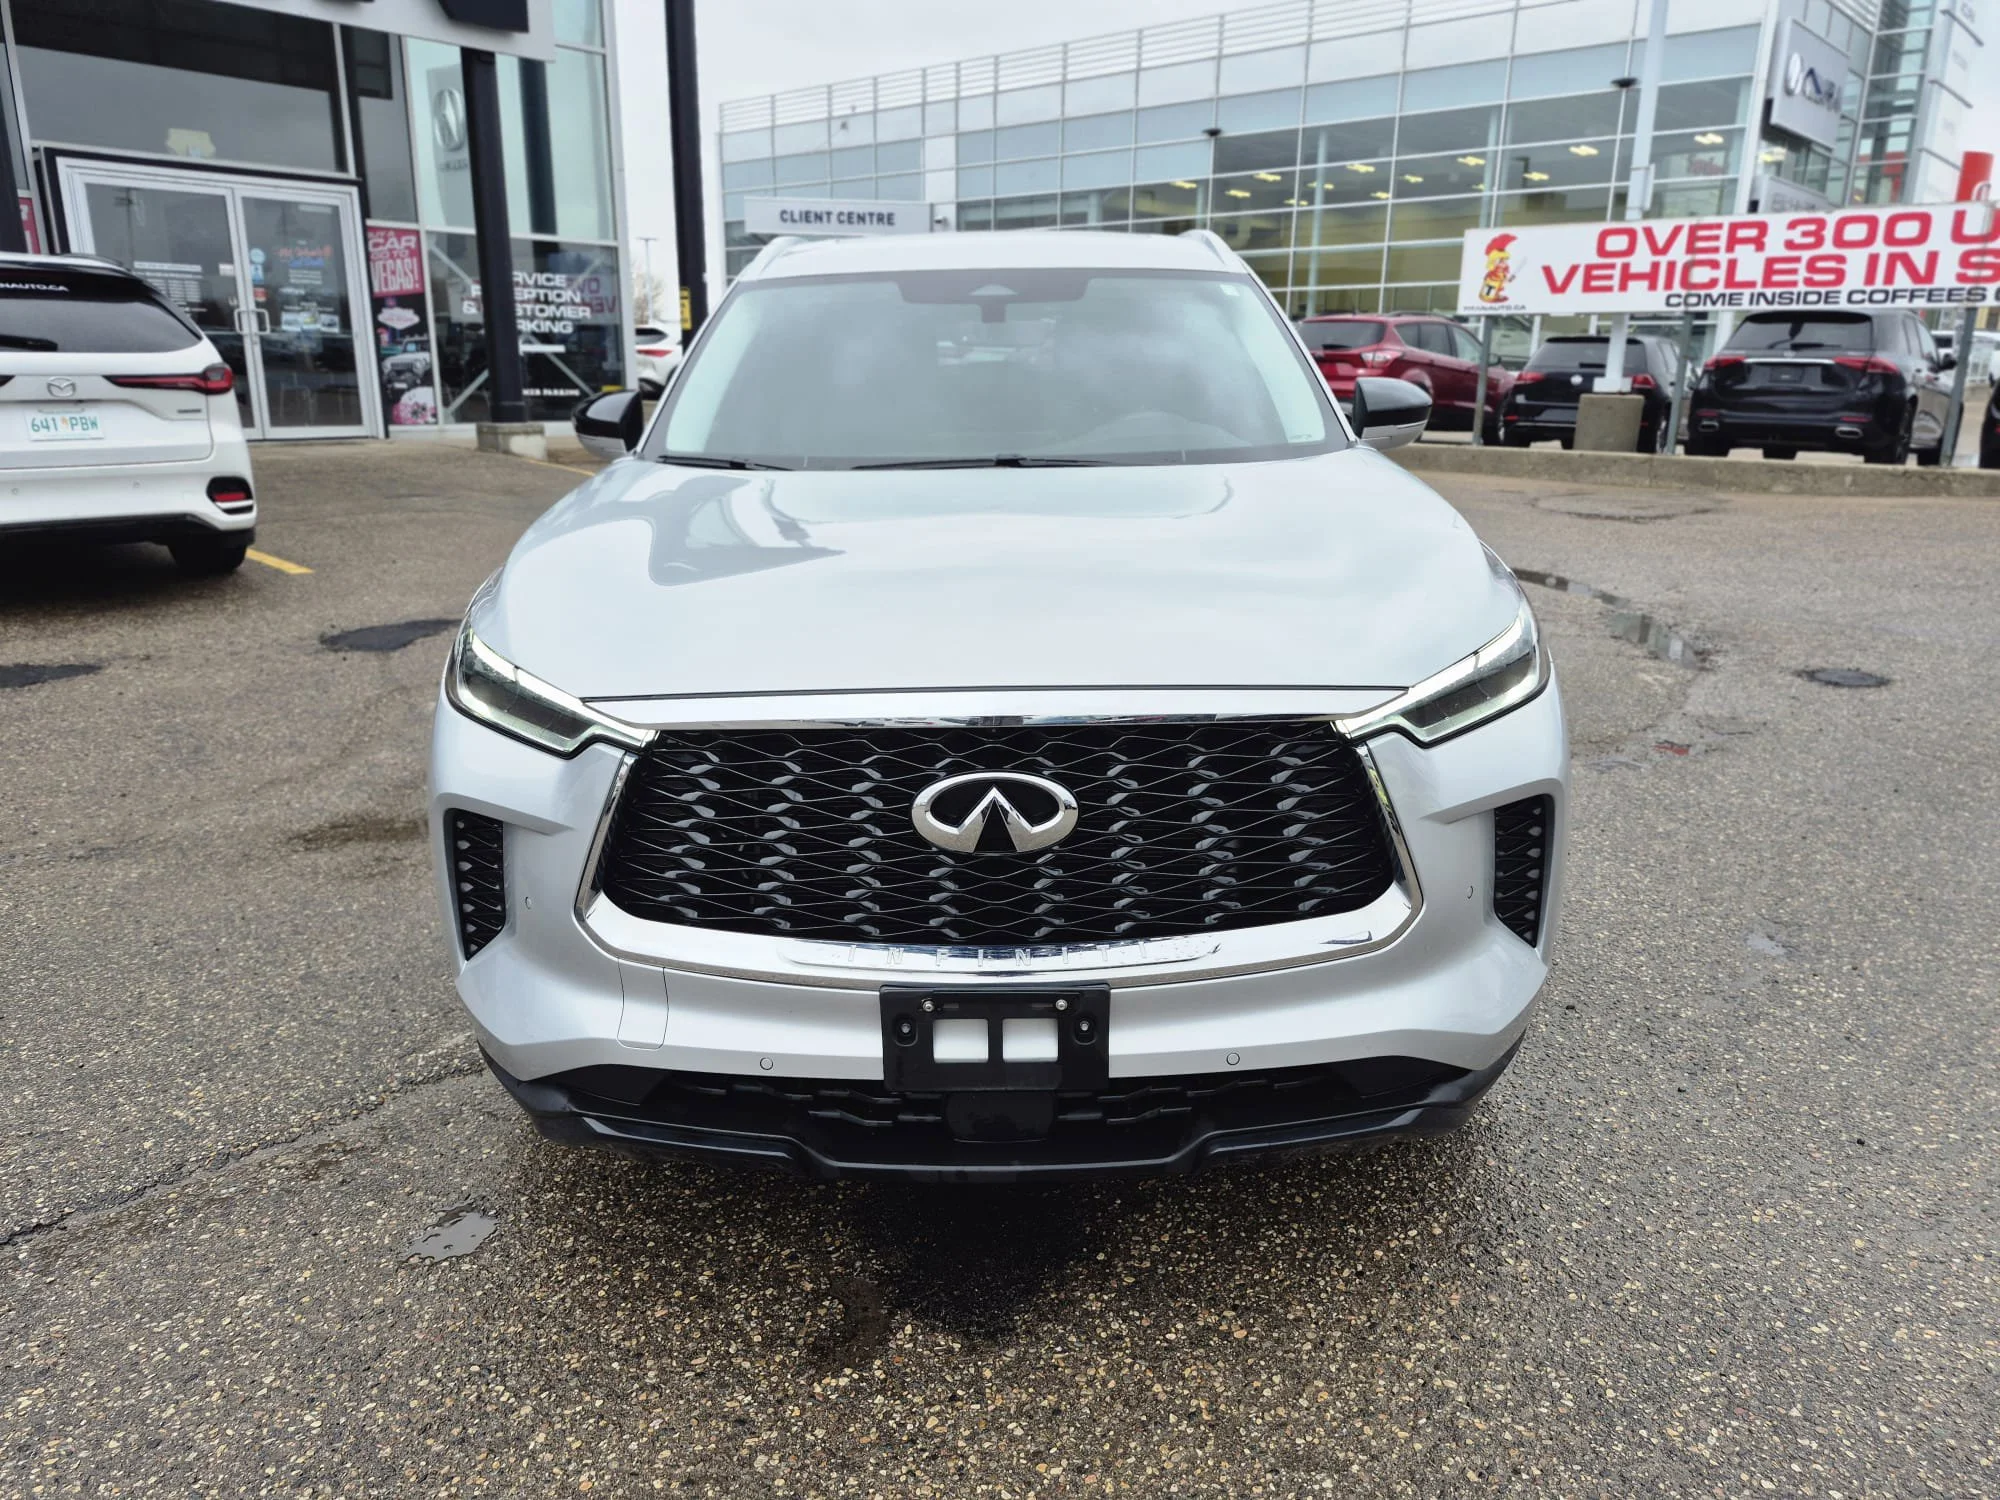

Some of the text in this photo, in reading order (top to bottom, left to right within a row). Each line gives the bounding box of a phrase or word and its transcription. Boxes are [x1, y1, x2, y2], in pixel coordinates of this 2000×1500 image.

[779, 209, 896, 226] CLIENT CENTRE
[368, 235, 417, 251] CAR
[1596, 220, 1769, 259] OVER
[1784, 211, 1933, 251] 300
[369, 256, 420, 292] VEGAS!
[512, 271, 568, 287] RVICE
[1541, 254, 1847, 295] VEHICLES
[1863, 251, 1940, 286] IN
[1664, 292, 1744, 308] COME
[1748, 290, 1842, 307] INSIDE
[1846, 286, 1988, 305] COFFEES
[462, 300, 478, 315] &
[515, 303, 592, 320] STOMER
[516, 318, 574, 334] RKING
[31, 416, 99, 432] 641 PBW
[848, 941, 1147, 968] INFINITI
